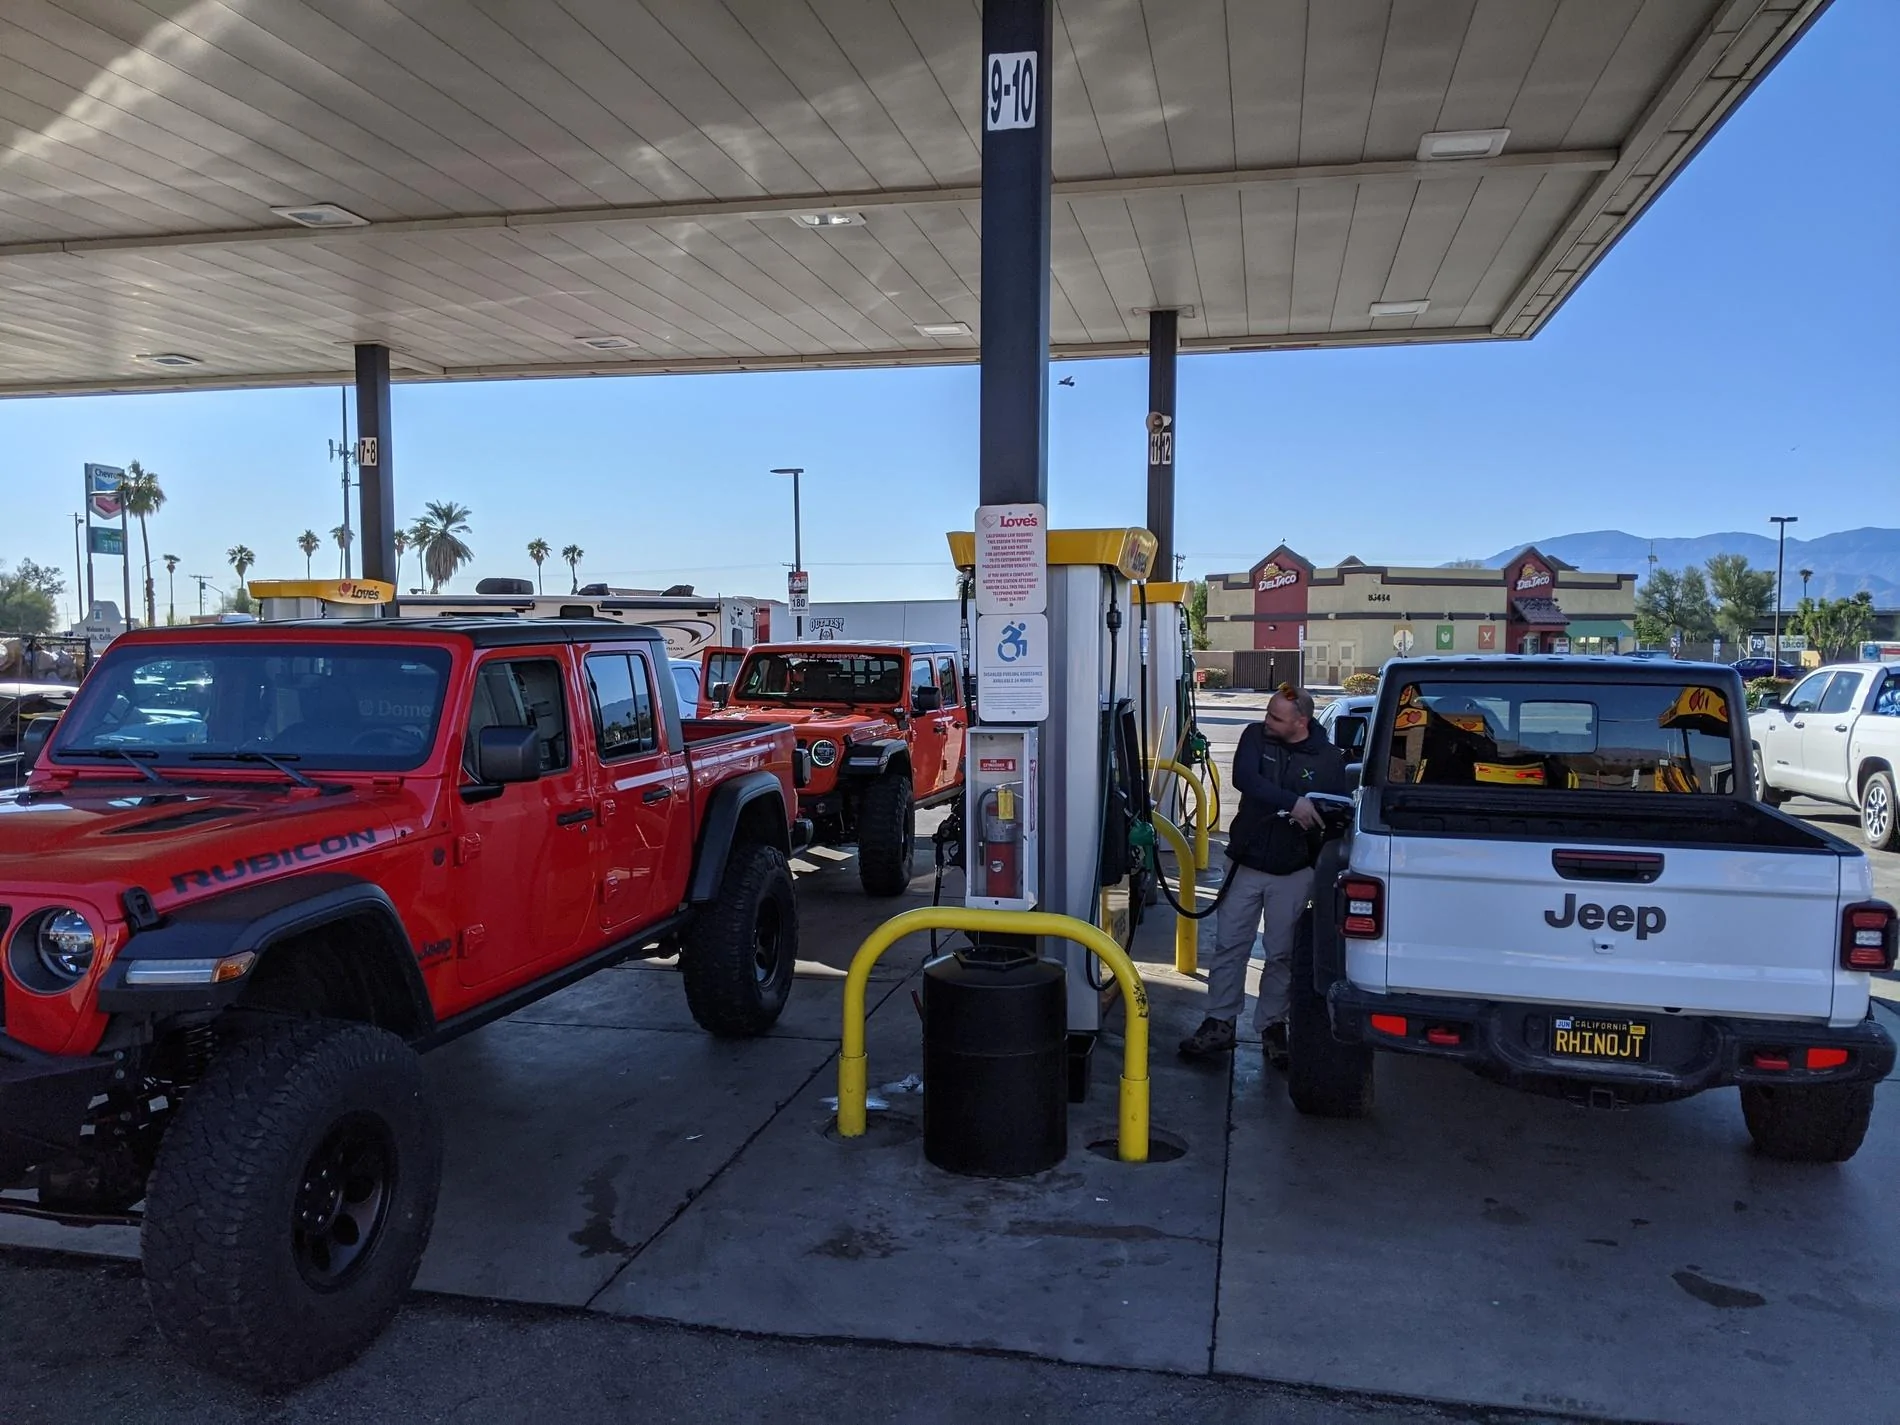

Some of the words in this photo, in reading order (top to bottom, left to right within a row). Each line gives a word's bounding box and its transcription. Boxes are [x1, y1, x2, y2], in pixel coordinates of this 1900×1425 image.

[990, 58, 1034, 124] 9-10
[360, 440, 376, 464] 7-8
[94, 468, 121, 480] Chevro
[1000, 513, 1038, 528] Love's
[351, 586, 380, 600] Love's
[792, 598, 806, 607] 180
[170, 827, 376, 894] RUBICON
[1544, 893, 1667, 940] Jeep
[1575, 1020, 1628, 1031] CALIFORNIA
[1555, 1030, 1644, 1058] RHINOJT
